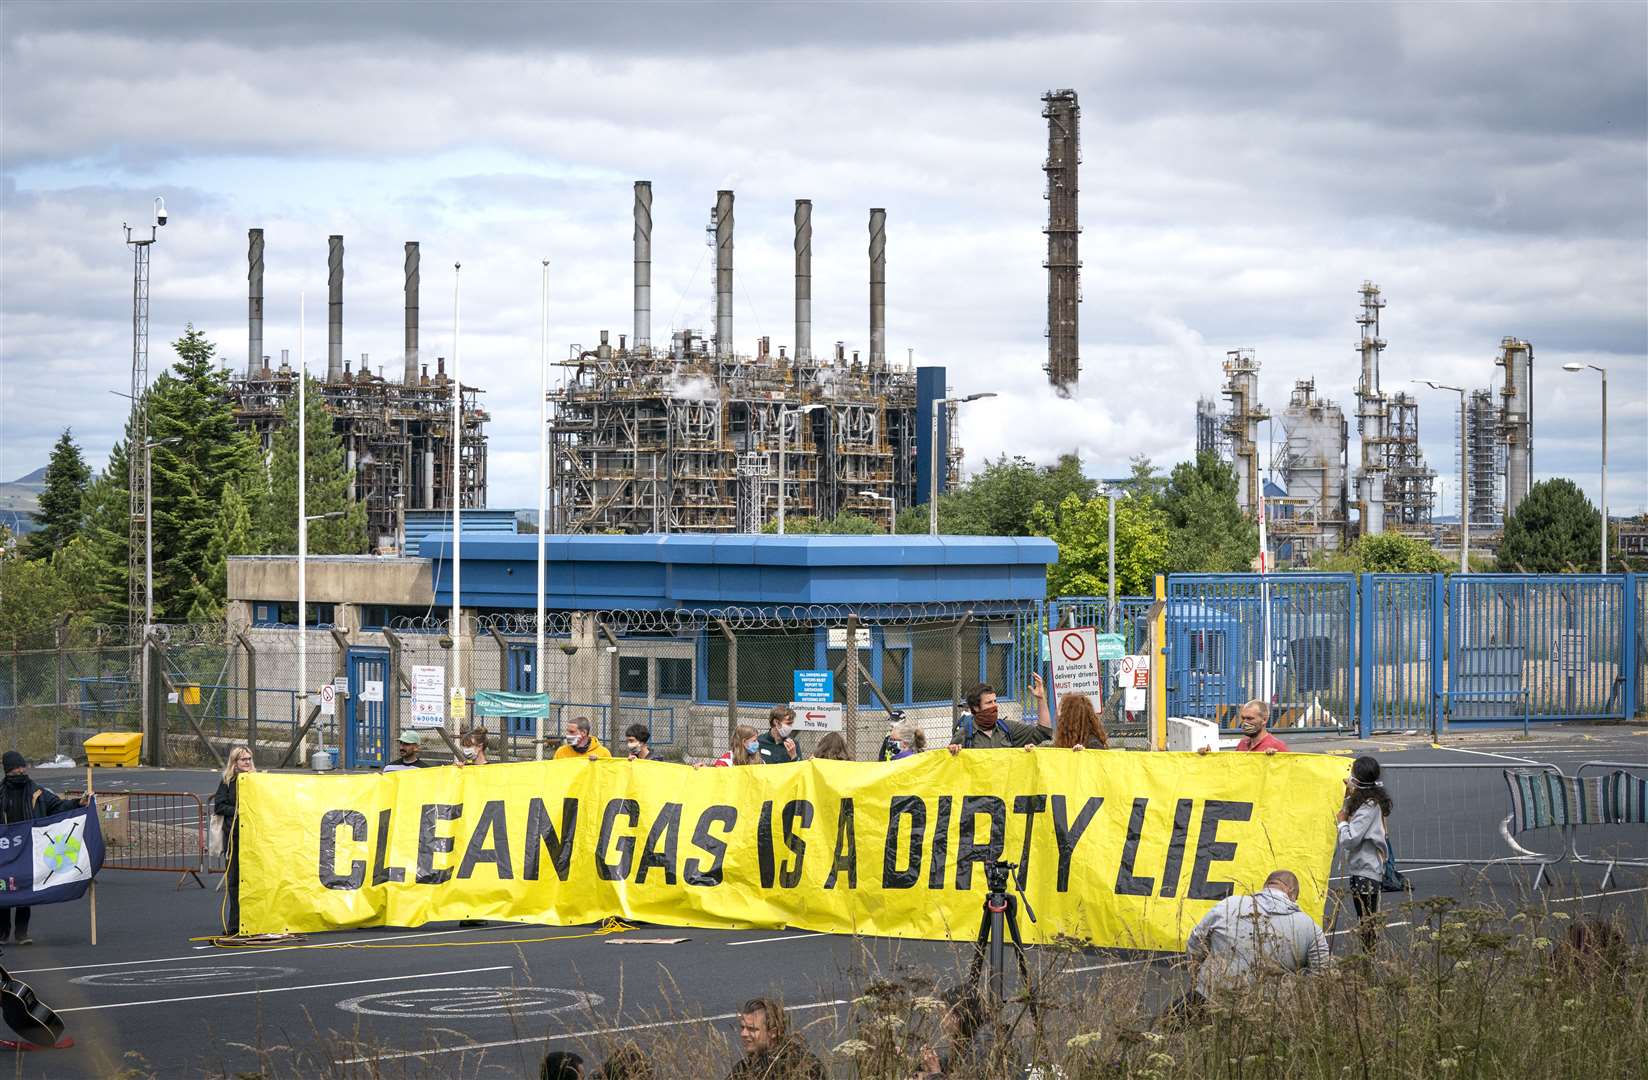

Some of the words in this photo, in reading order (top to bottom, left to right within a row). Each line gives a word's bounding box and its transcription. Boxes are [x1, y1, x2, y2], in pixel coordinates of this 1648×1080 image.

[1066, 663, 1087, 671] visitors
[319, 797, 579, 890] CLEAN
[595, 798, 738, 887] GAS
[757, 799, 814, 889] IS
[824, 798, 857, 889] A
[882, 795, 1104, 892] DIRTY
[1115, 798, 1254, 900] LIE
